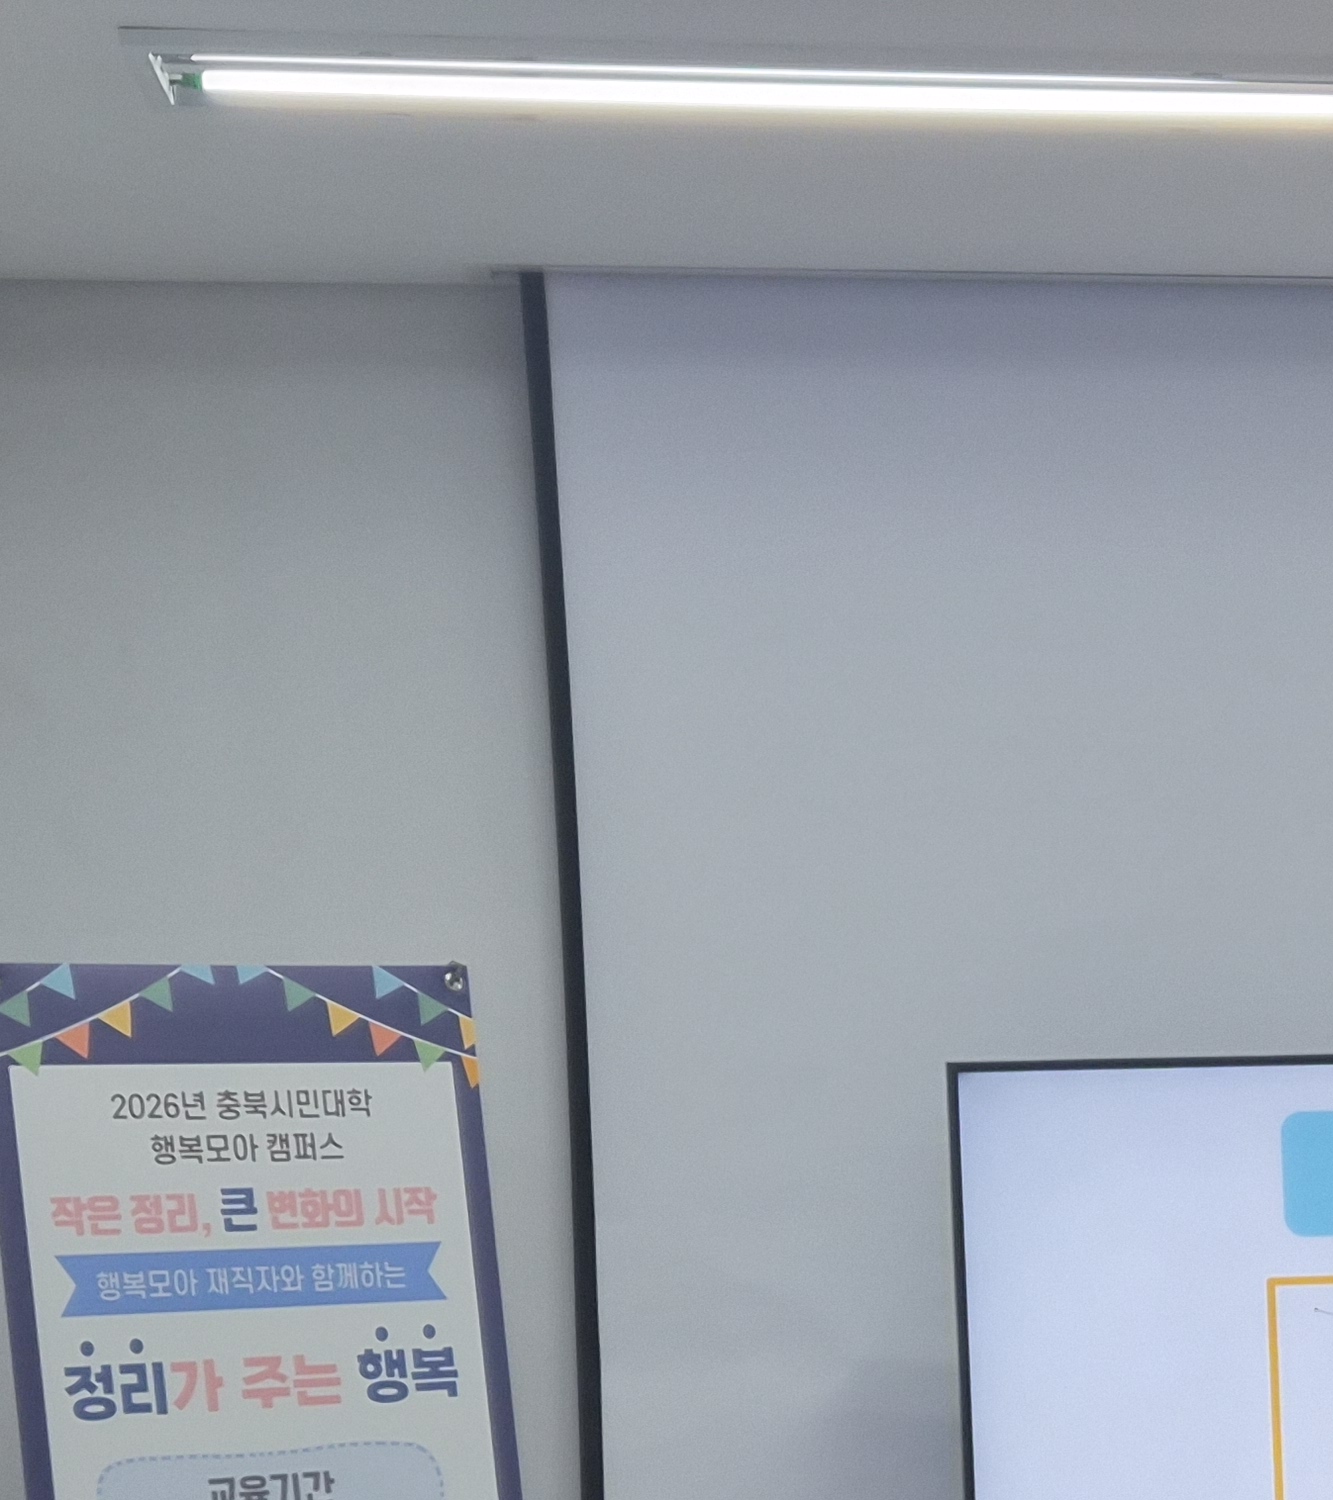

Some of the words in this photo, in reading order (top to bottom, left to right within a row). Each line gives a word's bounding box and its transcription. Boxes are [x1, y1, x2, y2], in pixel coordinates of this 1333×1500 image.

[111, 1090, 207, 1121] 2026년
[216, 1088, 373, 1121] 충북시민대학
[150, 1132, 258, 1166] 행복모아
[266, 1132, 345, 1163] 캠퍼스
[50, 1194, 122, 1237] 작은
[129, 1192, 212, 1238] 정리,
[219, 1186, 259, 1233] 큰
[266, 1187, 365, 1231] 변화의
[374, 1186, 438, 1227] 시작
[96, 1270, 198, 1302] 행복모아
[206, 1265, 304, 1294] 재직자와
[311, 1262, 407, 1291] 함께하는
[62, 1356, 225, 1422] 정리가
[241, 1353, 343, 1410] 주는
[356, 1345, 460, 1404] 행복
